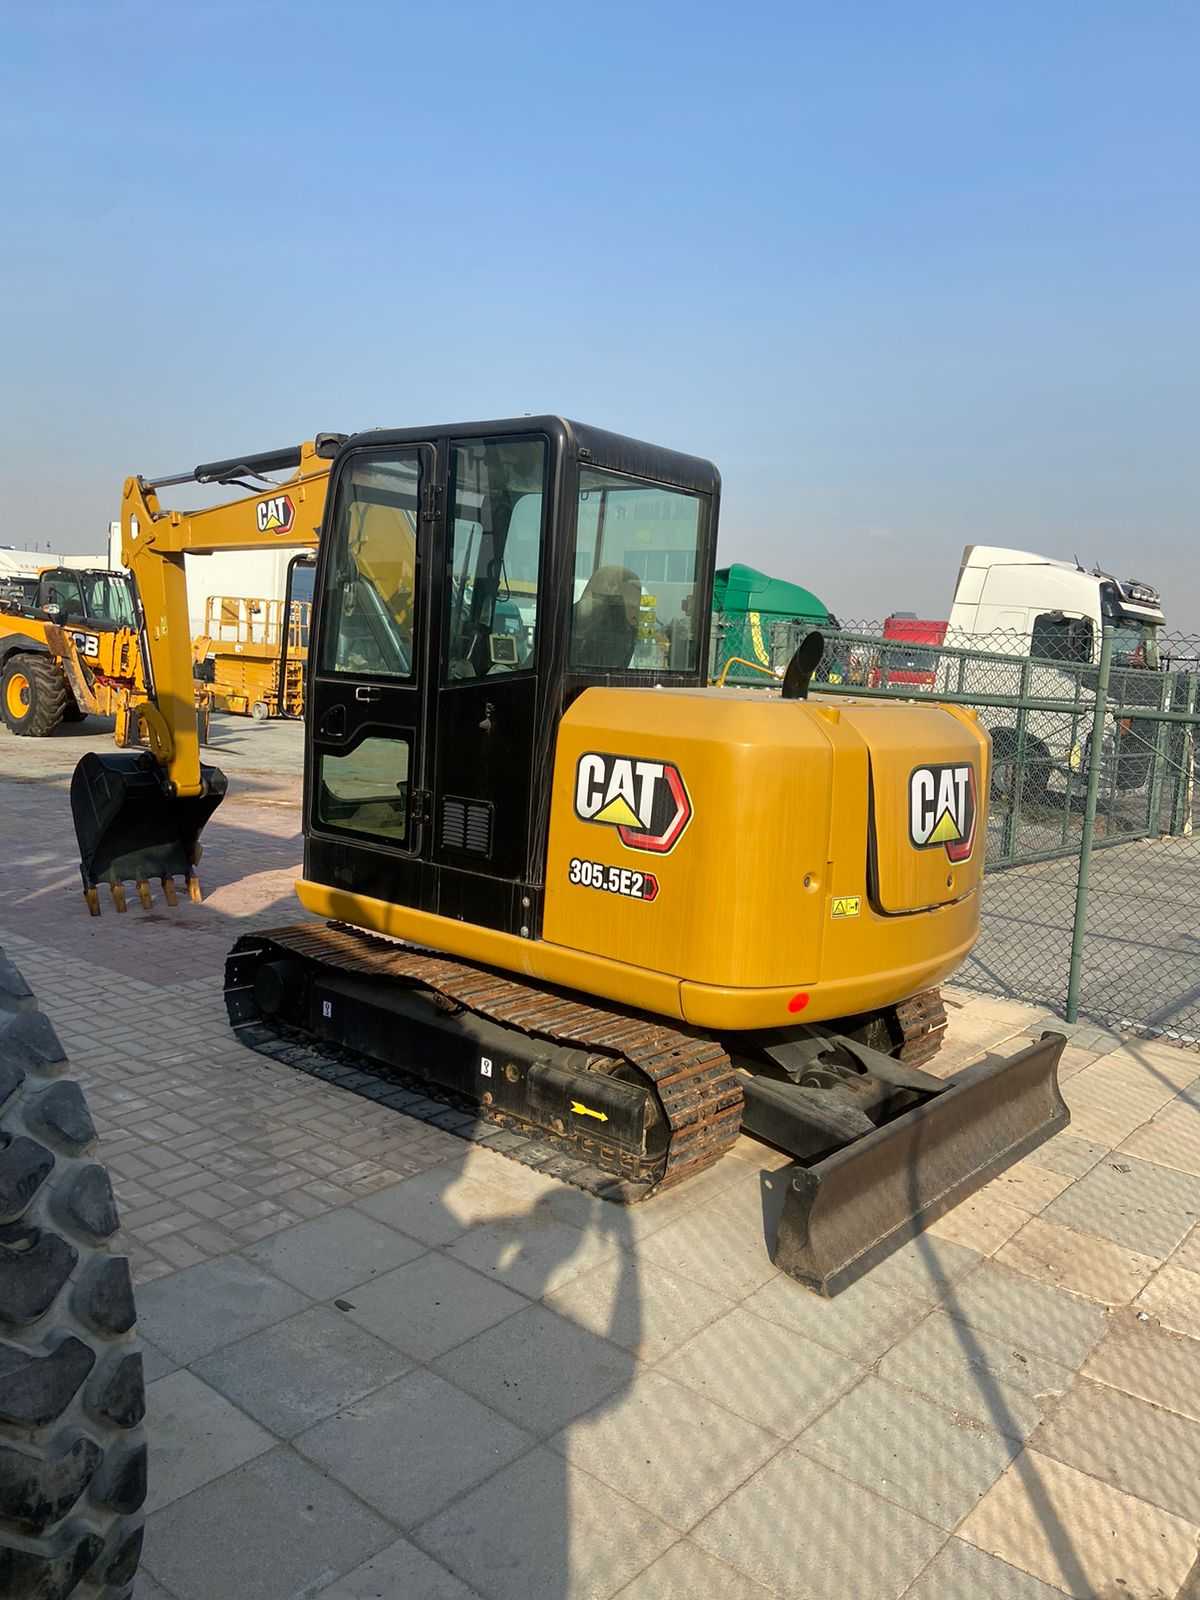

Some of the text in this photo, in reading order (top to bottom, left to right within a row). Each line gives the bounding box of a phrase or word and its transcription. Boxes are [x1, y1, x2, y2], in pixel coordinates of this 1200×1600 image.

[257, 496, 286, 530] CAT
[72, 633, 99, 657] CB
[576, 753, 664, 829] CAT
[911, 767, 969, 844] CAT
[570, 859, 643, 897] 305.5E2
